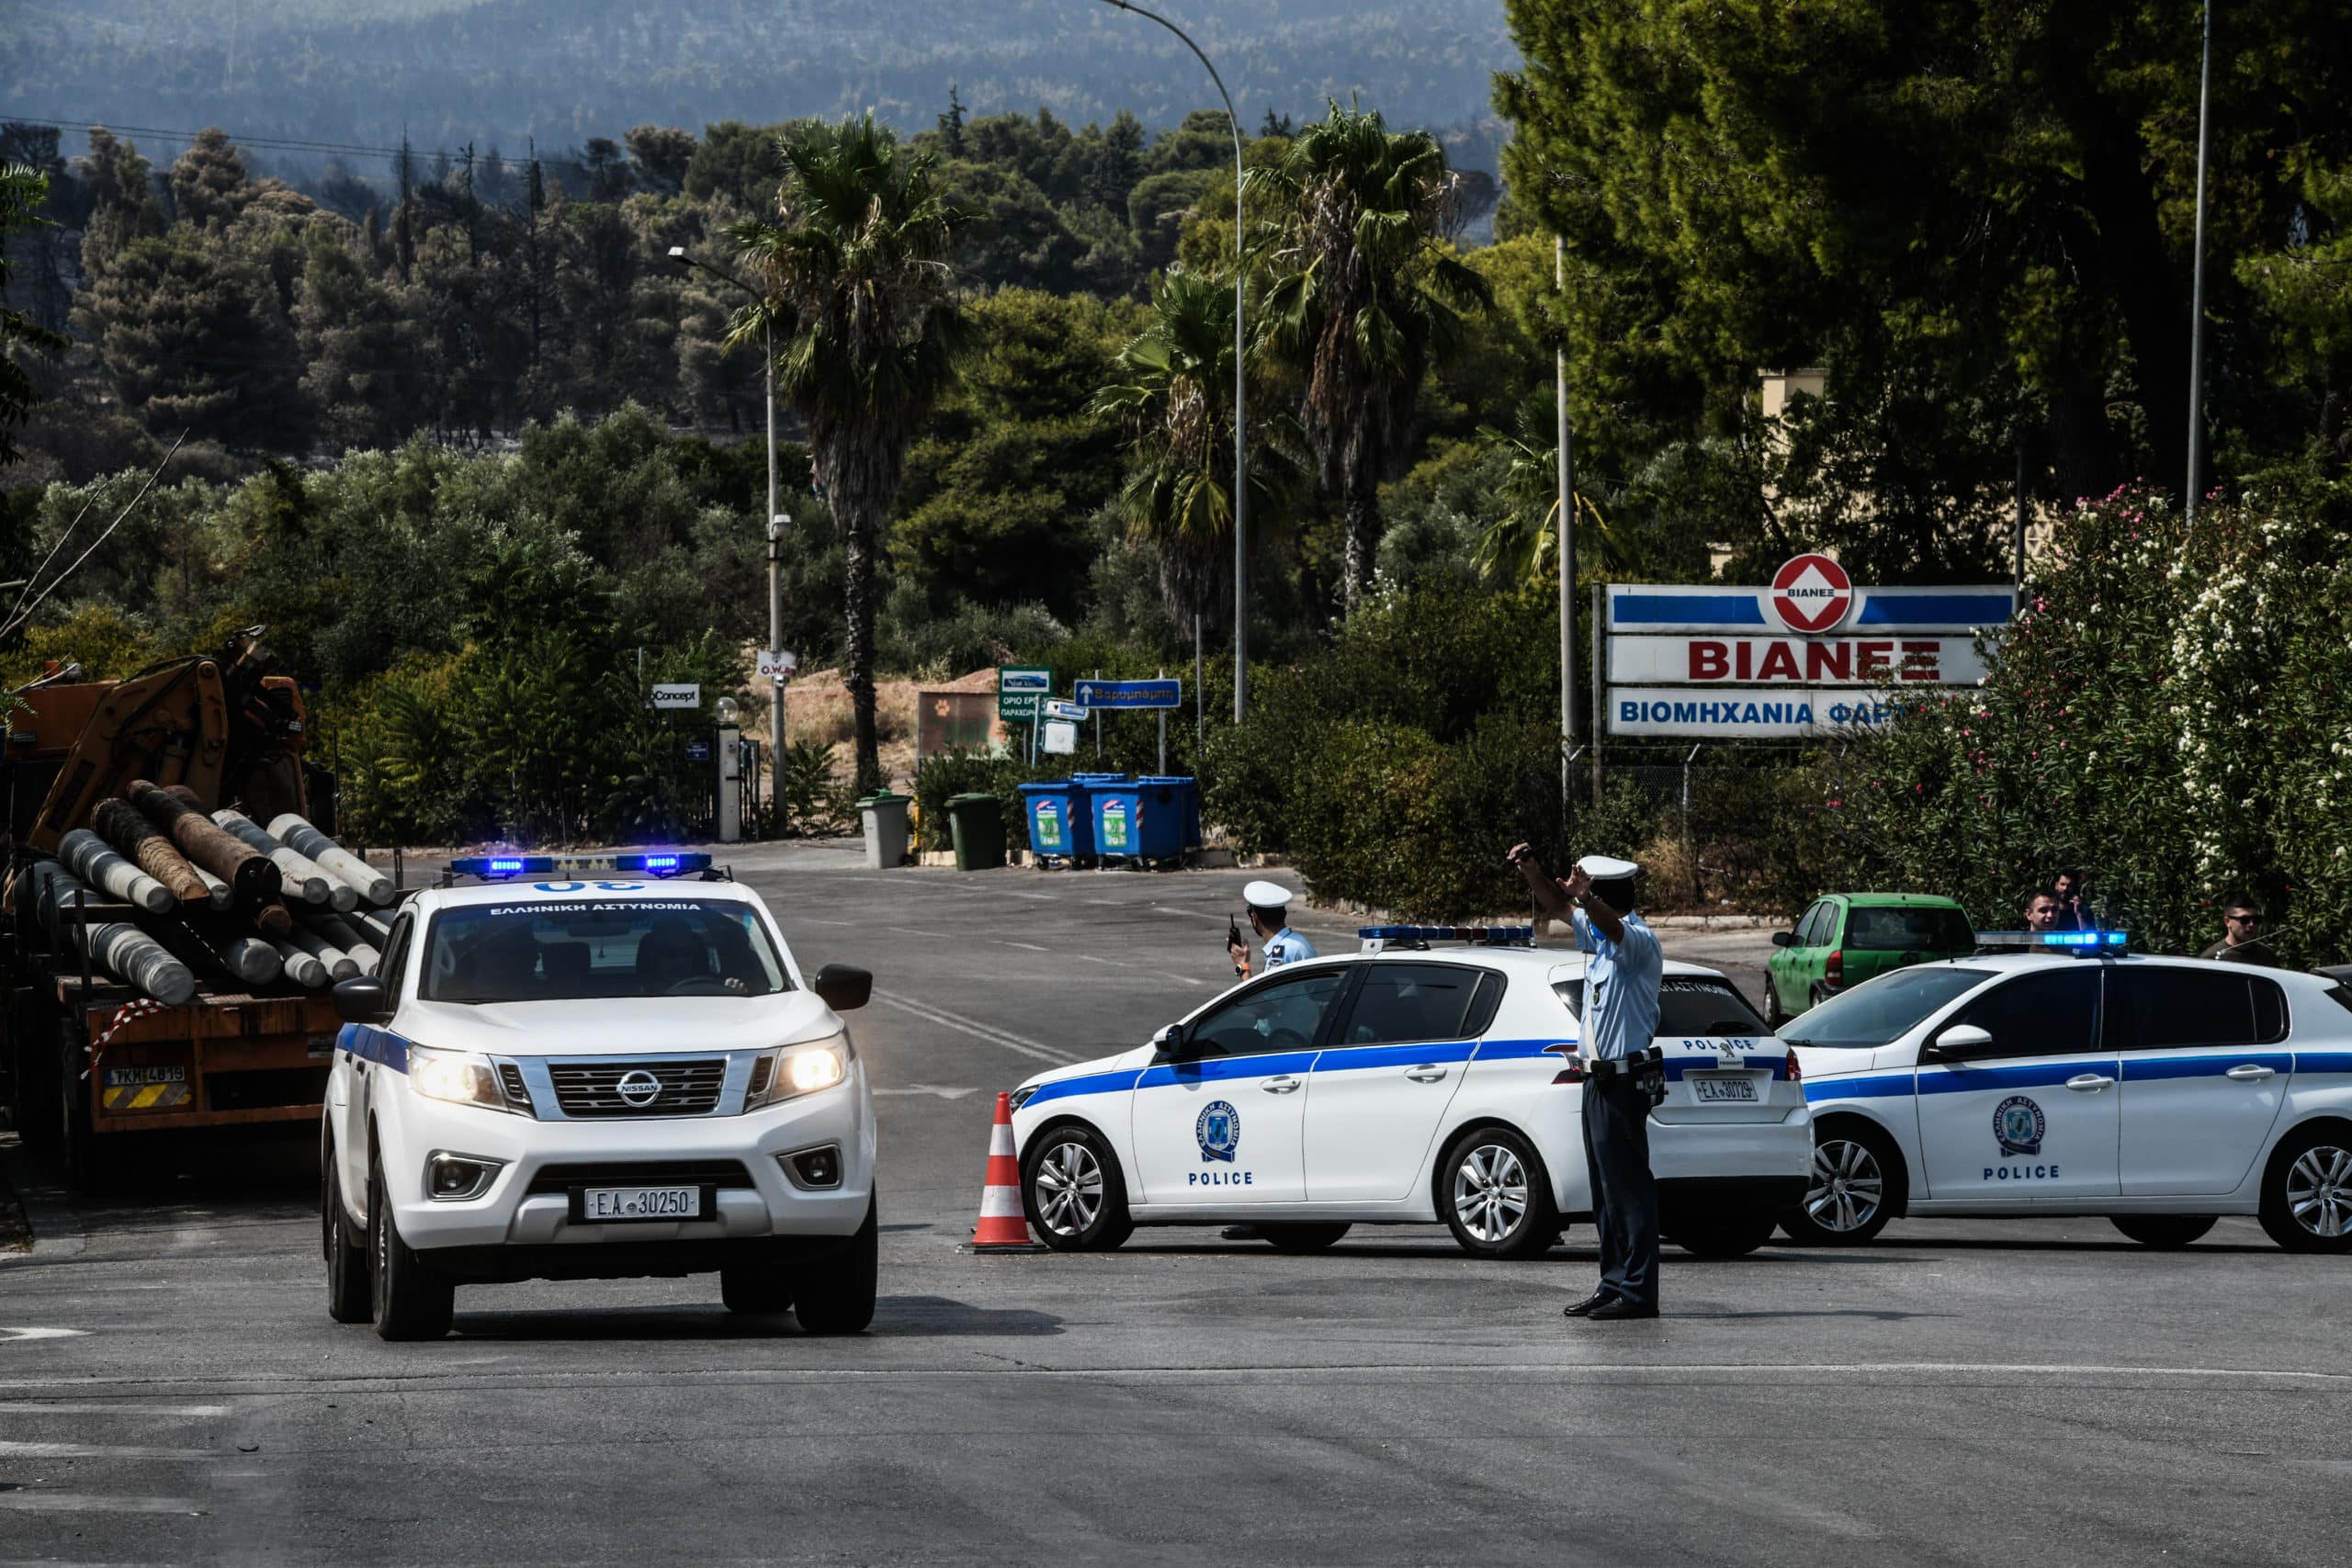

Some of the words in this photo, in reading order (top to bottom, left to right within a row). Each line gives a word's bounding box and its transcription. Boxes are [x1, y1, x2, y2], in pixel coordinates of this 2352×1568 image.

[1787, 588, 1835, 598] ΒΙΑΝΕΞ
[1689, 641, 1939, 681] ΒΙΑΝΕΞ
[1620, 701, 1814, 725] ΒΙΟΜΗΧΑΝΙΑ
[1828, 702, 1906, 724] ΦΑΡ
[491, 903, 587, 916] ΕΛΛΗΝΙΚΗ
[593, 902, 701, 912] ΑΣΤΥΝΟΜΙΑ
[1683, 1039, 1755, 1051] POLICE
[621, 1084, 659, 1092] NISSAN
[1189, 1172, 1252, 1186] POLICE
[1984, 1165, 2059, 1180] POLICE
[638, 1190, 688, 1214] 30250
